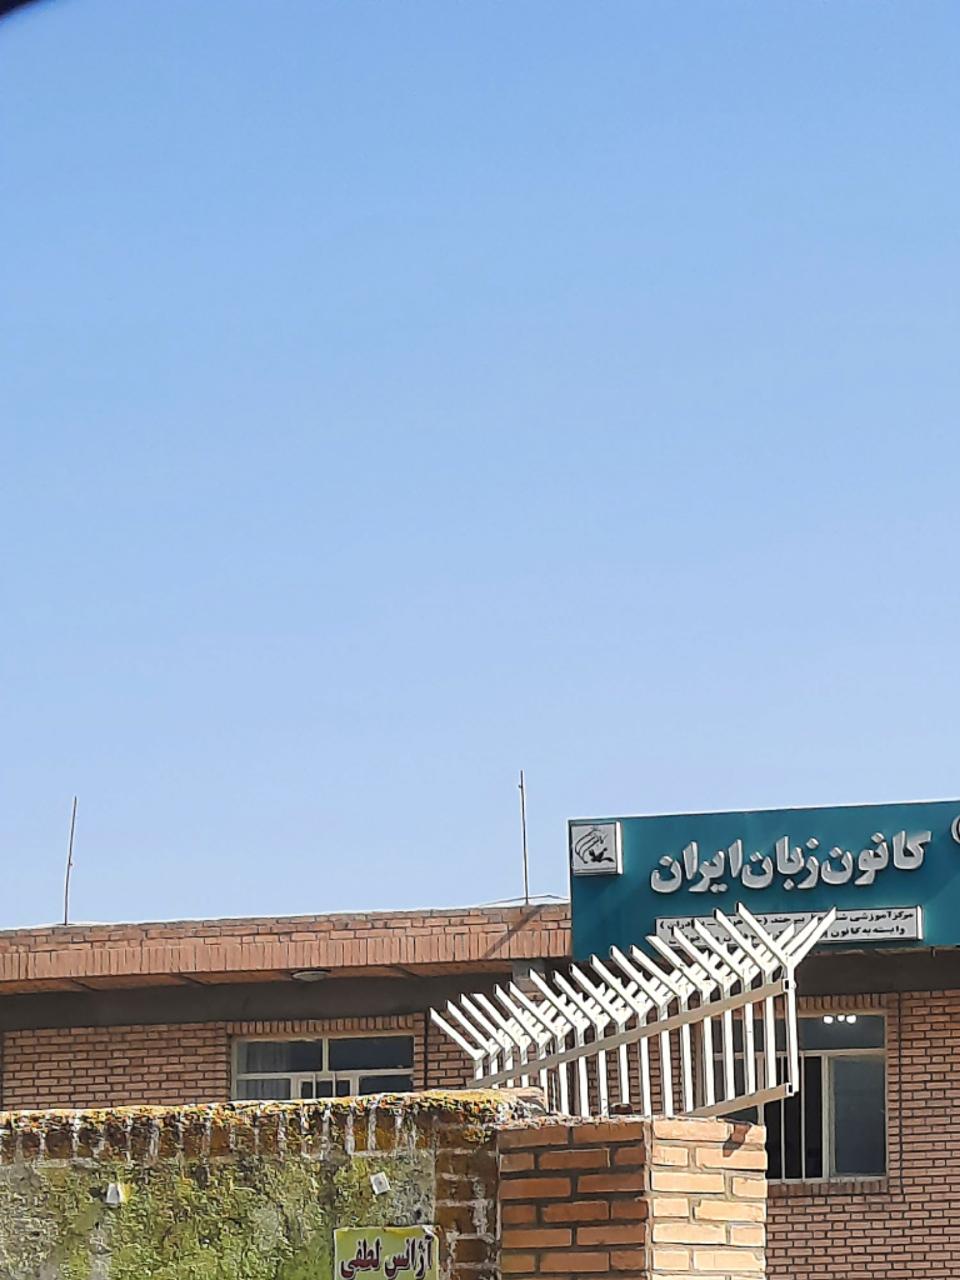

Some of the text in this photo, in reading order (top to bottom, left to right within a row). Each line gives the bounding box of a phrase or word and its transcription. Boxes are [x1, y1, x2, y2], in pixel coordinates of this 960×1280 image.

[650, 830, 932, 894] کانون زبان ایران
[849, 910, 892, 922] آموزشی
[892, 910, 915, 922] مرکز
[830, 925, 862, 939] کانون
[861, 926, 871, 936] به
[873, 924, 905, 936] وابسته
[340, 1234, 434, 1280] آژانس لطفی
